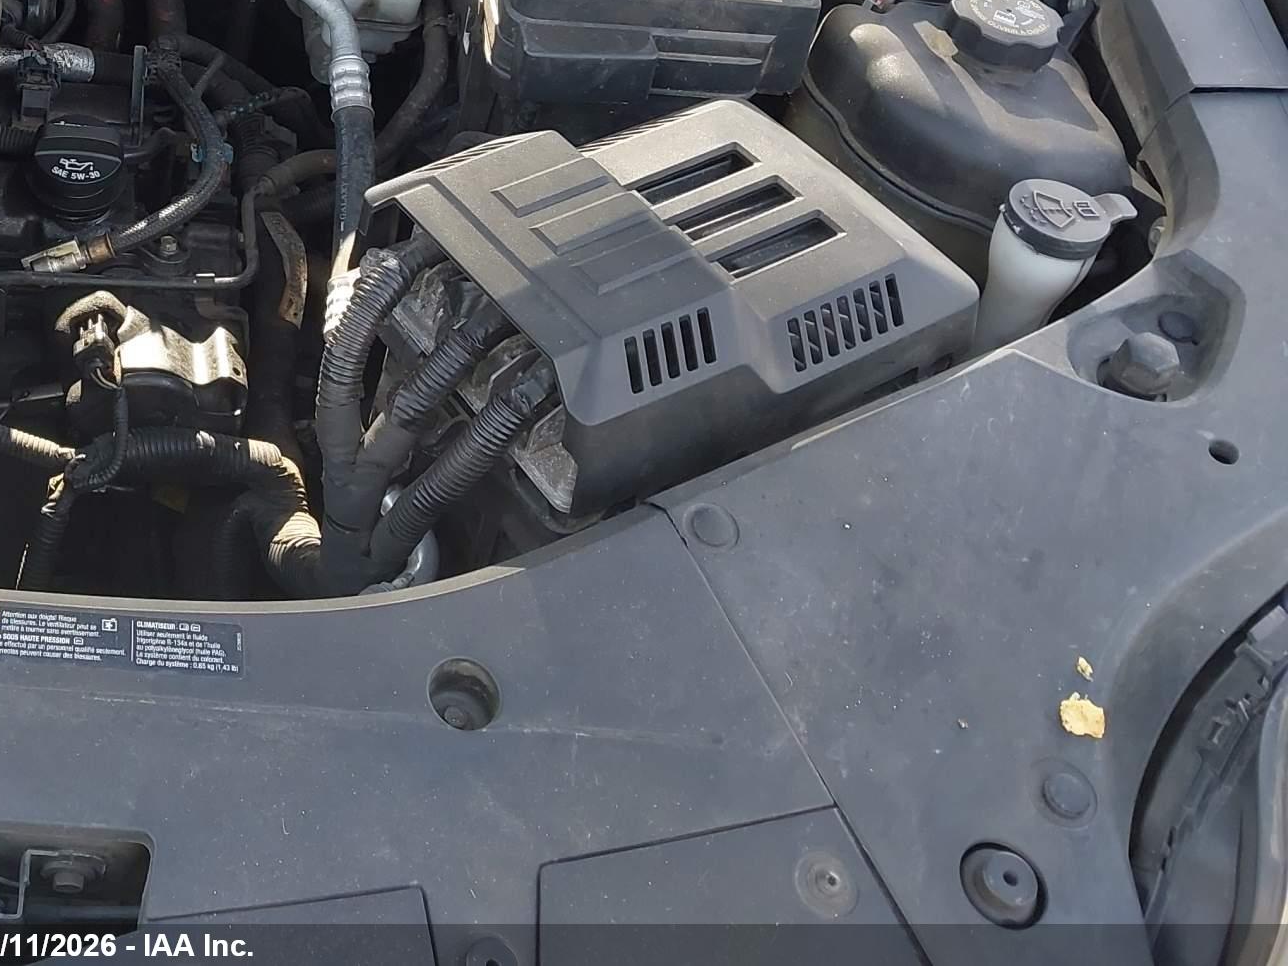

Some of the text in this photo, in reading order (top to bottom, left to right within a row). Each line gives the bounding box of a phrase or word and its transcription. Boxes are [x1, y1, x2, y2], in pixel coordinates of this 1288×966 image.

[51, 166, 101, 180] SAE 5W-30
[339, 182, 348, 220] GALAXY
[137, 621, 175, 629] CLIMATISEUR
[41, 636, 70, 644] PRESSION
[47, 644, 73, 652] personnel
[136, 658, 155, 666] Charge
[207, 663, 214, 671] kg
